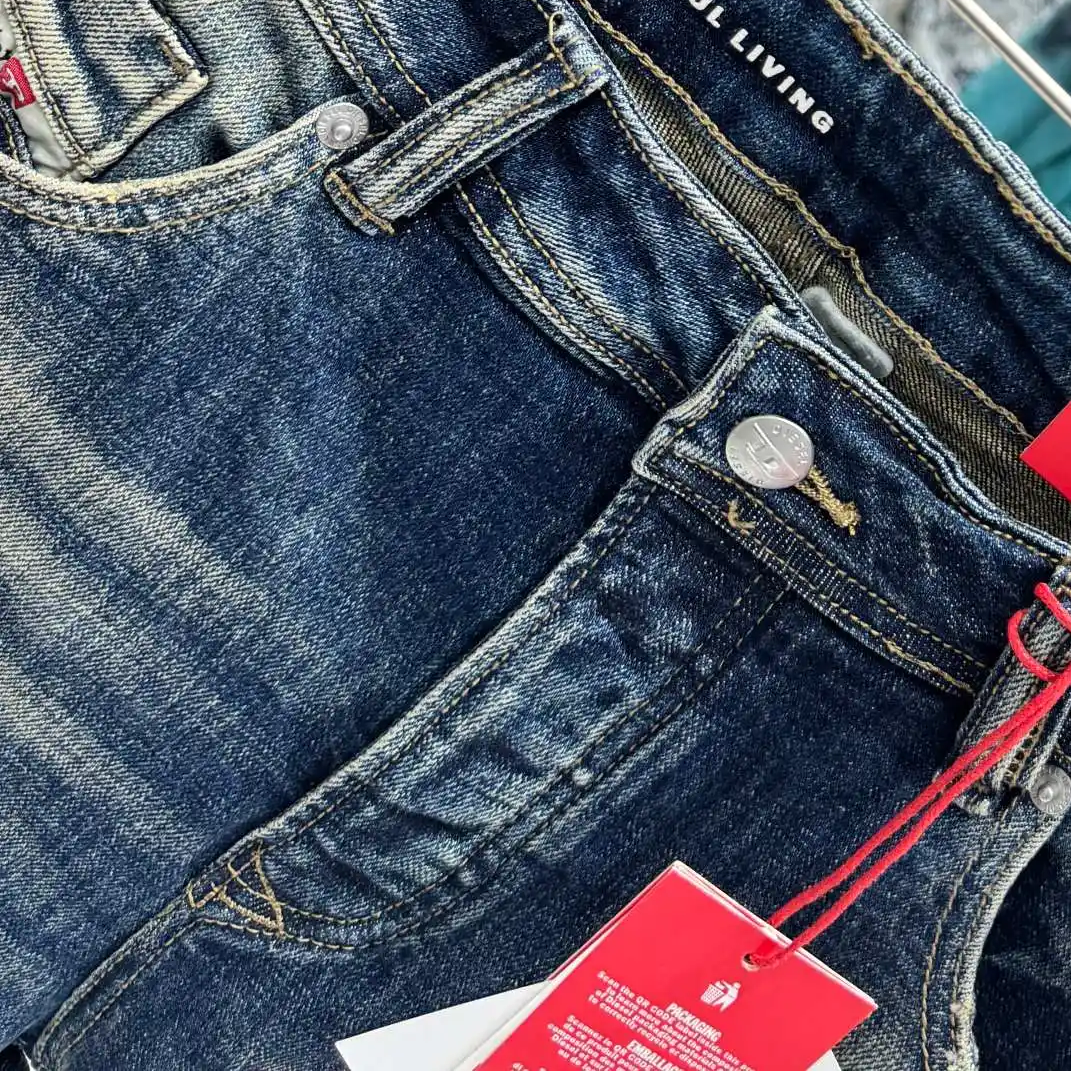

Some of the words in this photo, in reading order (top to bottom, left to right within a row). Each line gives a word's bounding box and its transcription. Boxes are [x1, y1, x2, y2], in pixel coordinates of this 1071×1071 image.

[729, 28, 834, 135] LIVING
[596, 969, 621, 989] Scan
[619, 984, 636, 999] the
[634, 994, 651, 1009] QR
[649, 1004, 676, 1024] CODE
[605, 985, 617, 997] to
[546, 1021, 599, 1059] composition
[597, 1000, 638, 1031] correctly
[636, 1025, 669, 1050] recycle
[604, 994, 634, 1017] Diesel
[631, 1012, 677, 1046] packaging
[665, 1000, 722, 1043] PACKAGING
[550, 1032, 579, 1055] Diesel
[612, 1043, 628, 1057] QR
[626, 1052, 653, 1071] CODE
